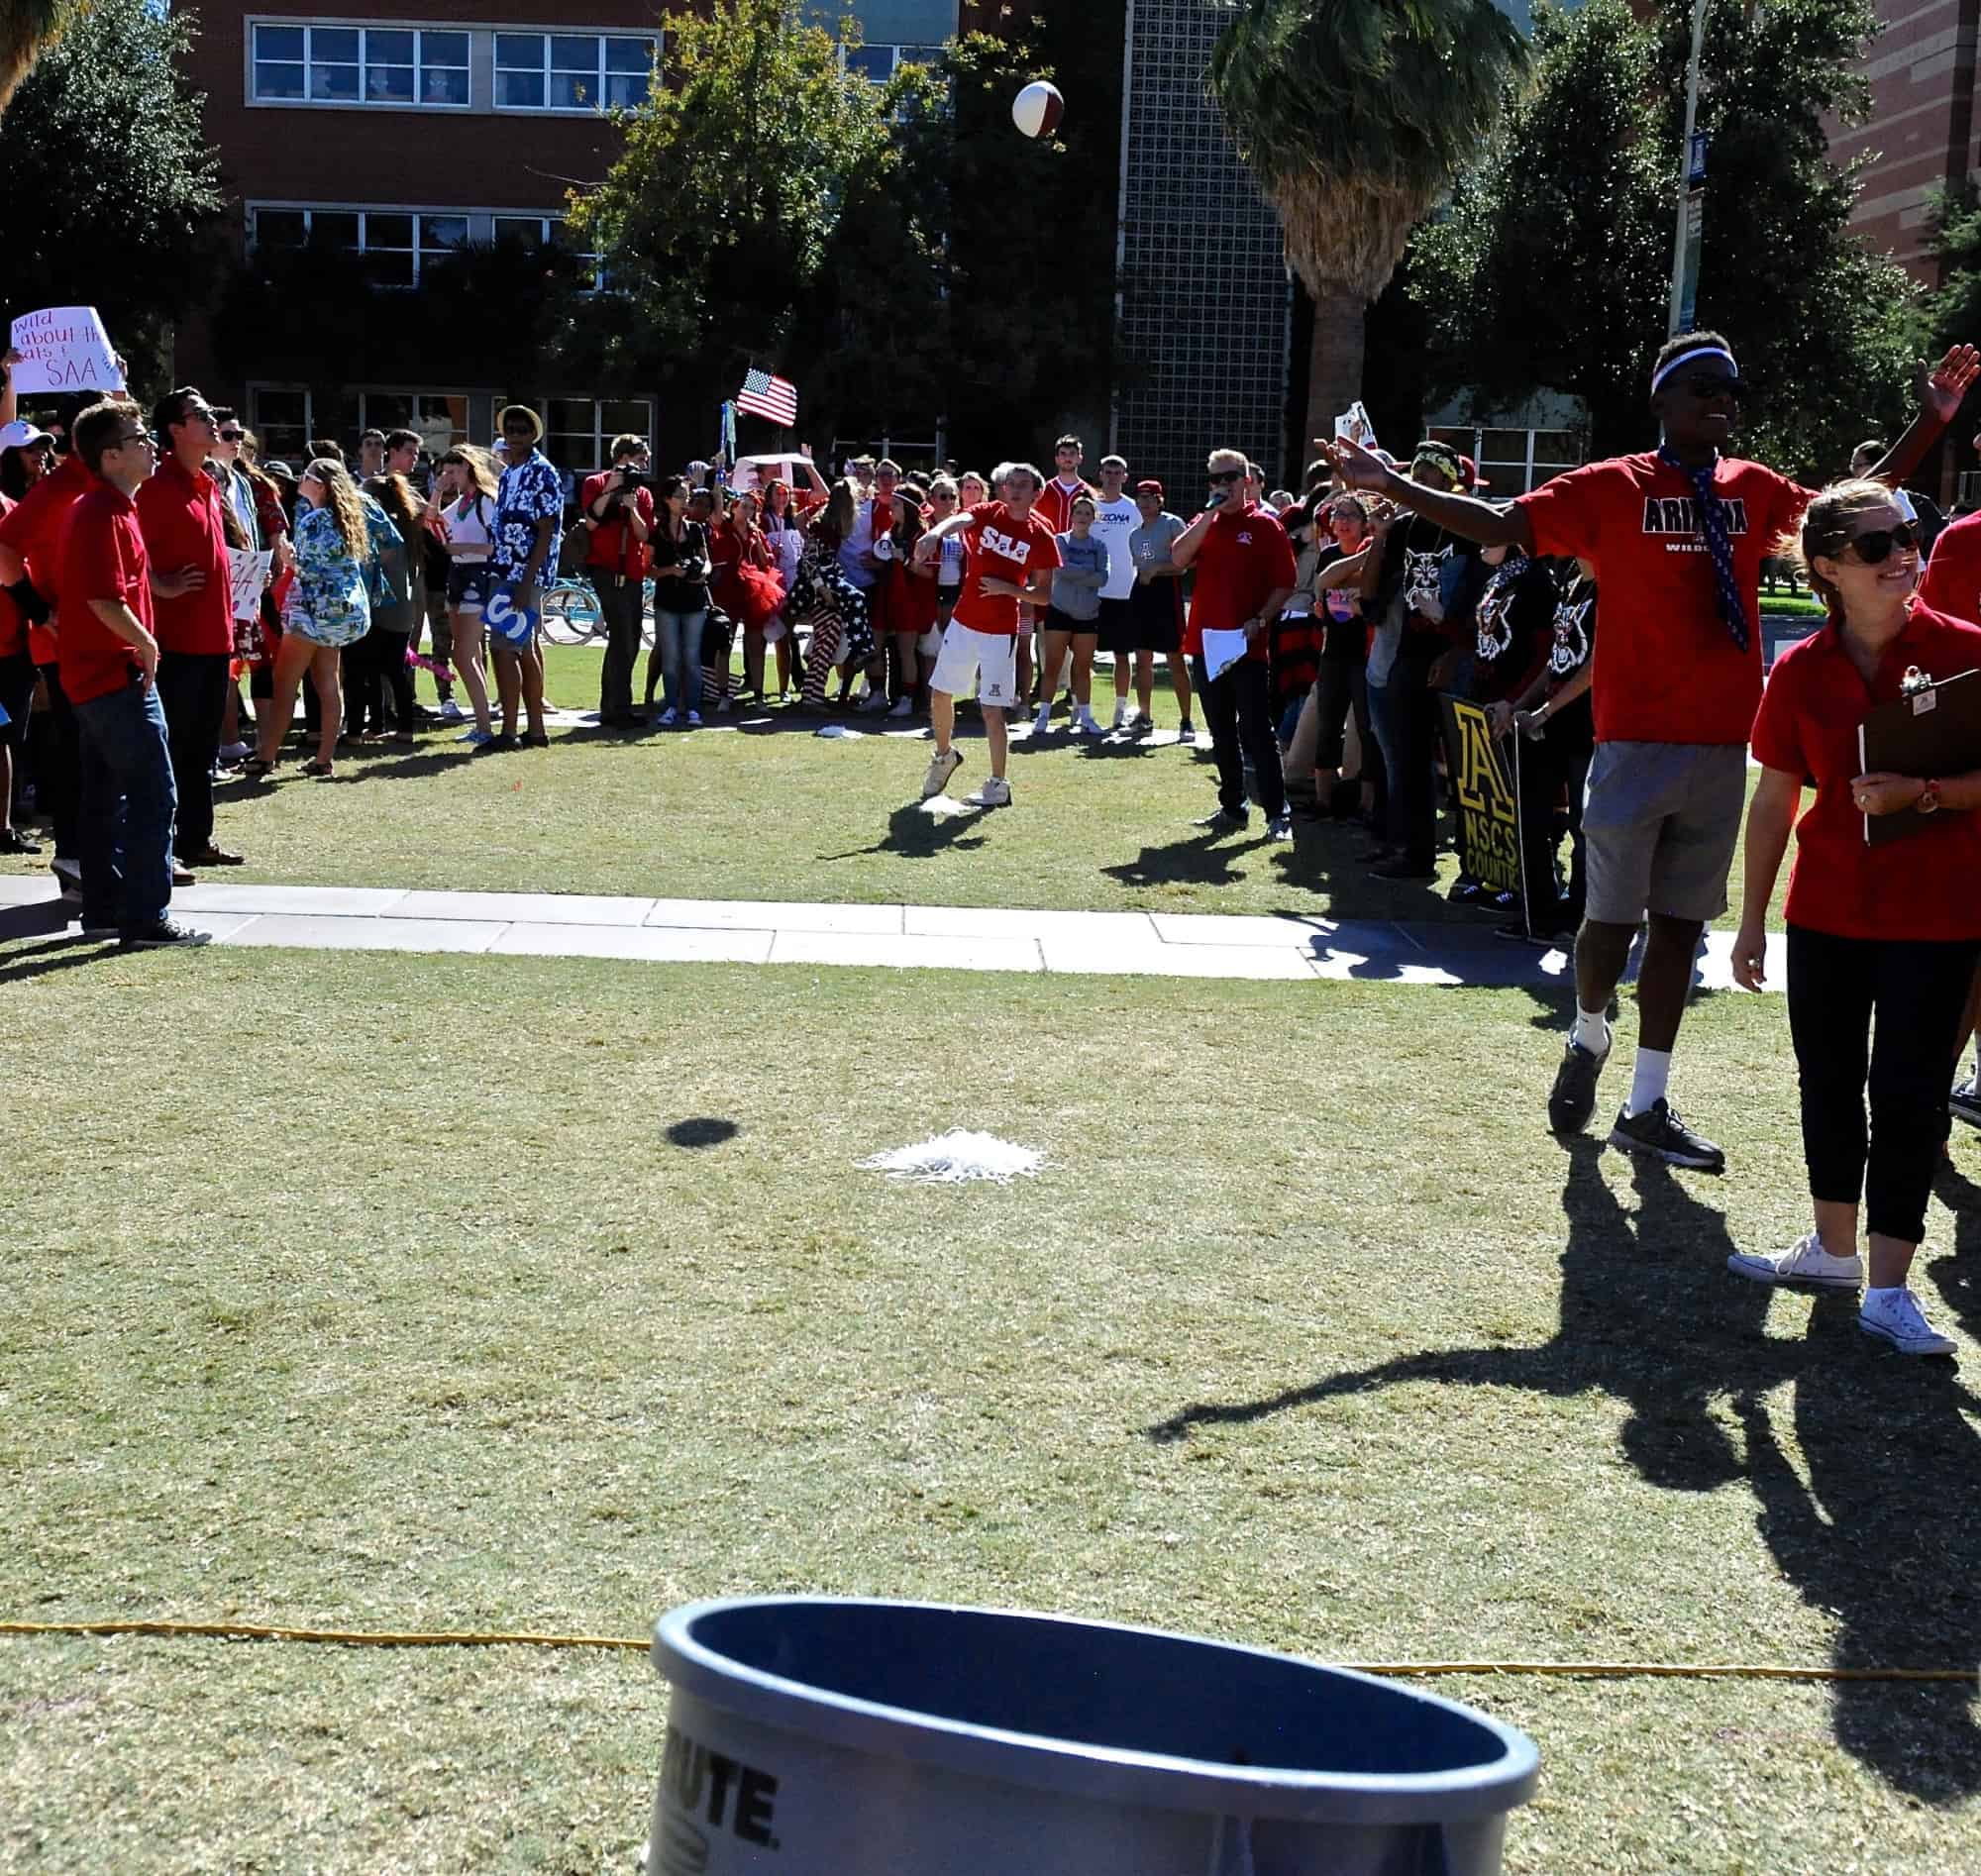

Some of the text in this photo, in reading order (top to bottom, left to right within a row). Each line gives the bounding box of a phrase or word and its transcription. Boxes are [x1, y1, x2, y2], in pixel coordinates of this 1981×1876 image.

[14, 310, 52, 334] wild
[20, 327, 74, 347] about
[46, 357, 97, 386] SAA
[486, 593, 528, 640] S
[1452, 701, 1515, 825] A
[1464, 808, 1517, 867] NSCS
[1466, 847, 1520, 890] COUNTR
